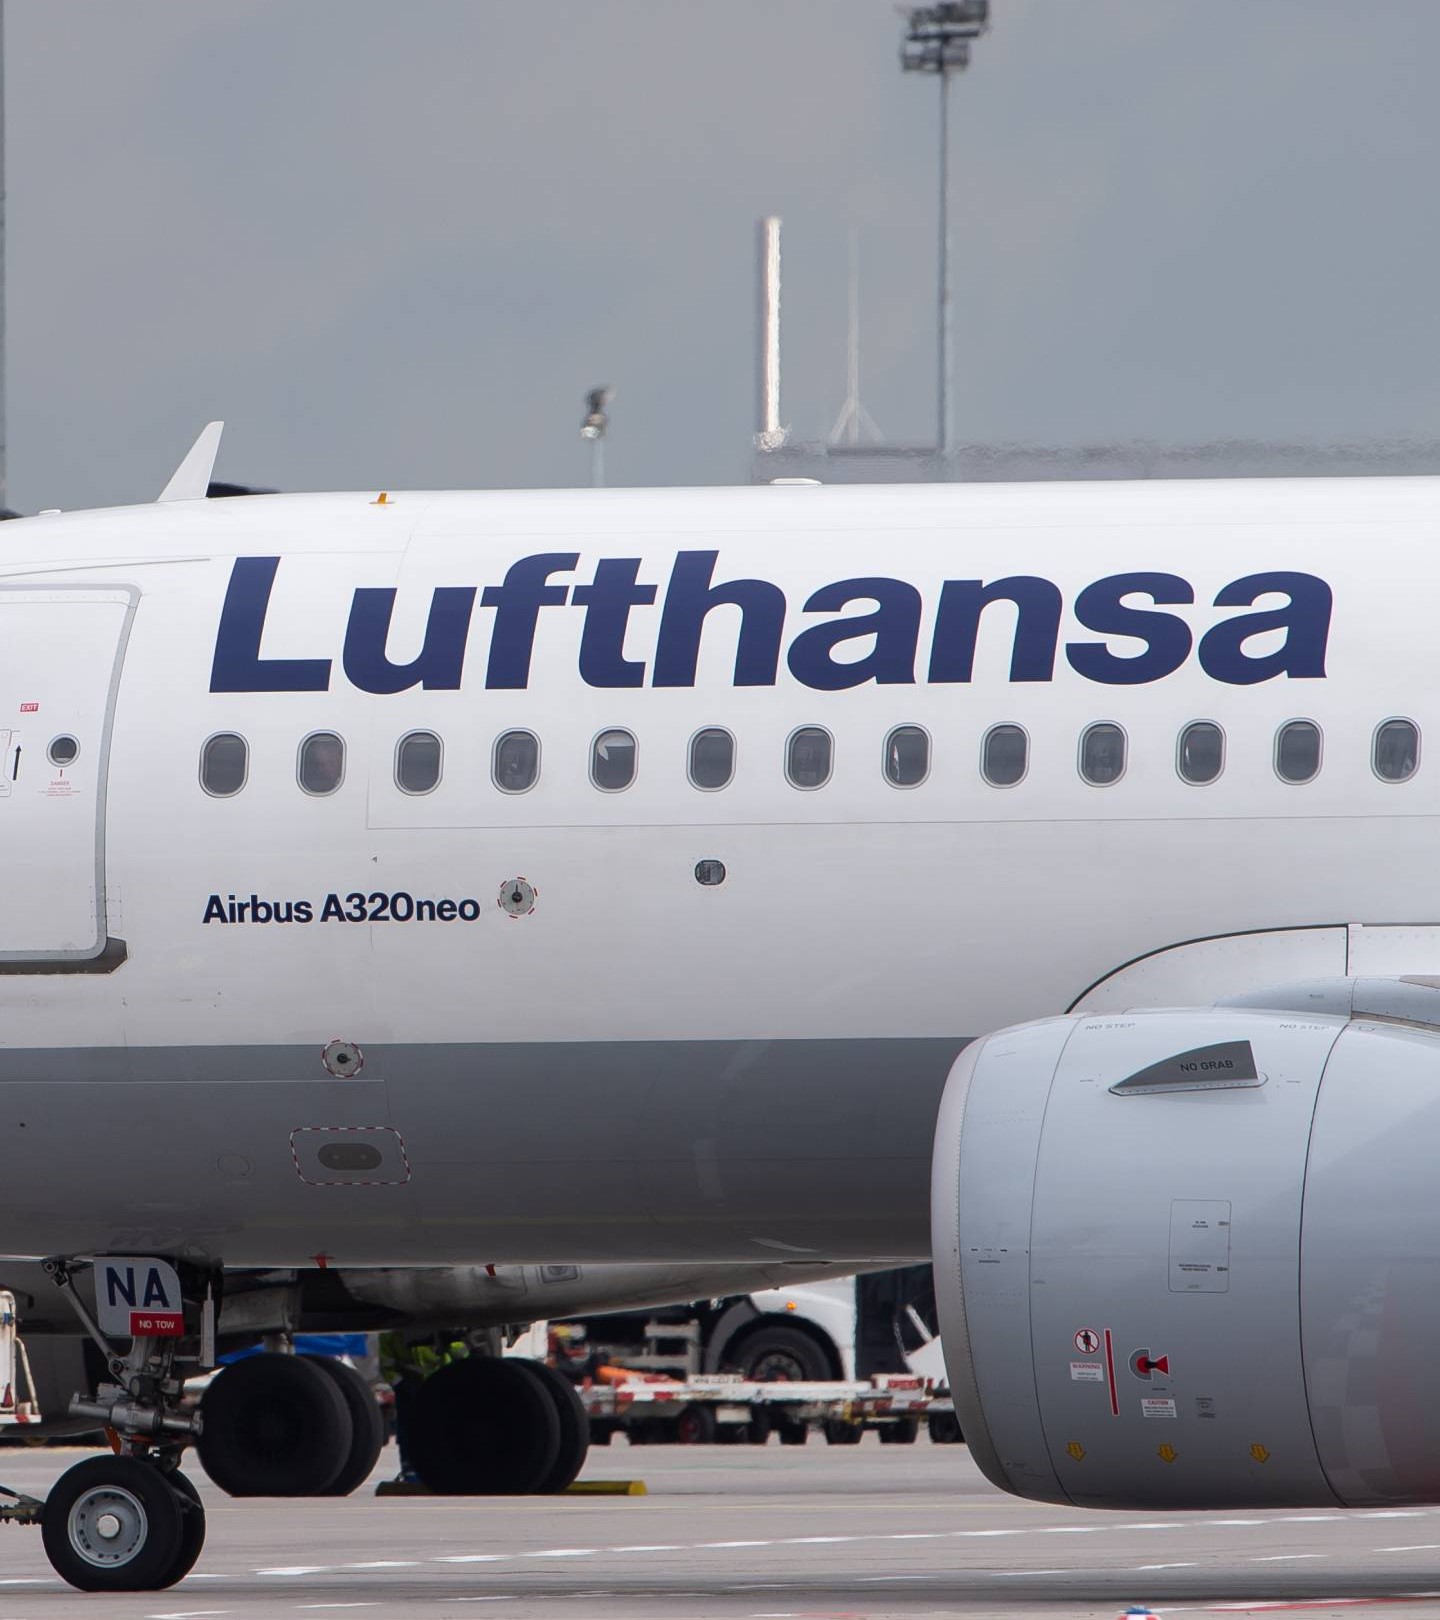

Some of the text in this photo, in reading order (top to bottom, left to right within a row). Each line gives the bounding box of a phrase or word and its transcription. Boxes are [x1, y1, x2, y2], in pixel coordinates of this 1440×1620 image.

[209, 550, 1333, 693] Lufthansa
[202, 892, 480, 924] Airbus A320neo
[1180, 1060, 1233, 1072] NO GRAB
[106, 1266, 170, 1308] NA
[139, 1320, 175, 1329] NO TOW
